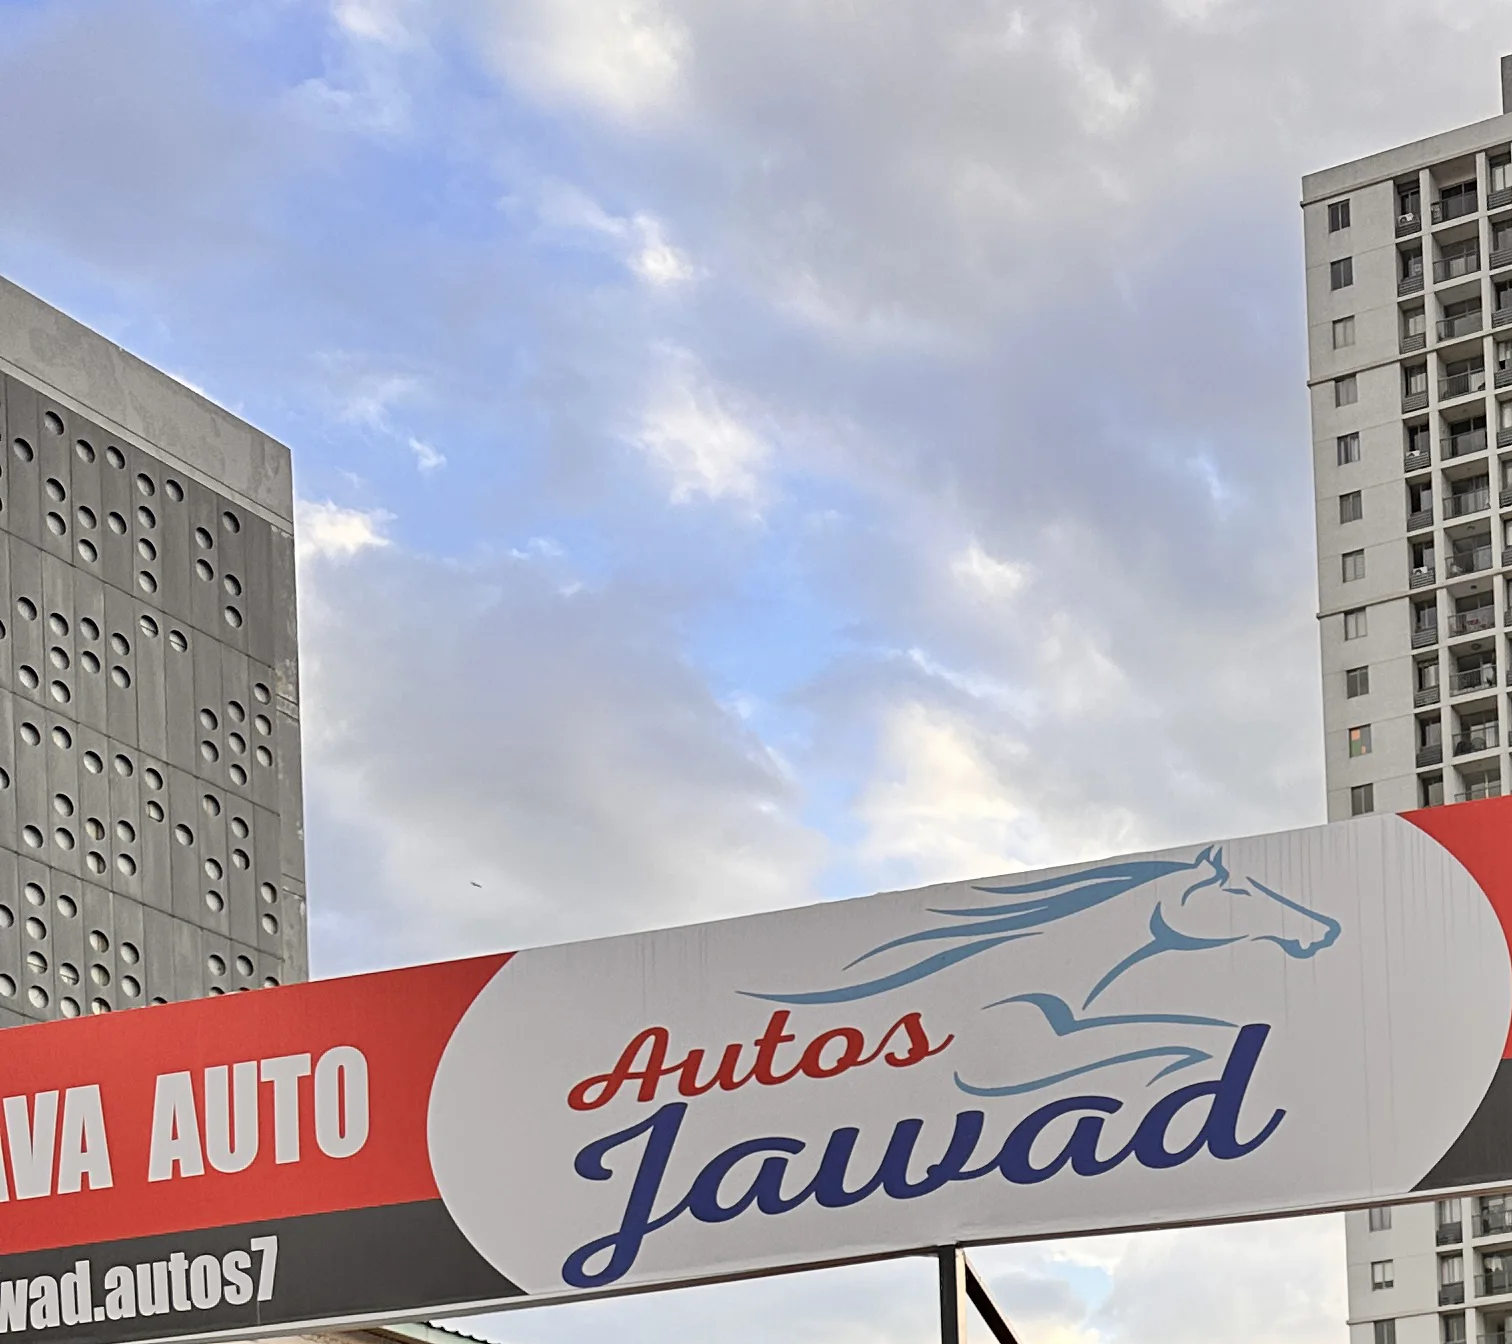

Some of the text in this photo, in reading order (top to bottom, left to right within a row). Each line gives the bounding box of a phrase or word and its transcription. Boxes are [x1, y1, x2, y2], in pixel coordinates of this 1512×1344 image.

[0, 1045, 370, 1202] VA AUTO
[566, 1008, 954, 1112] Autos
[560, 1023, 1287, 1288] Jawad
